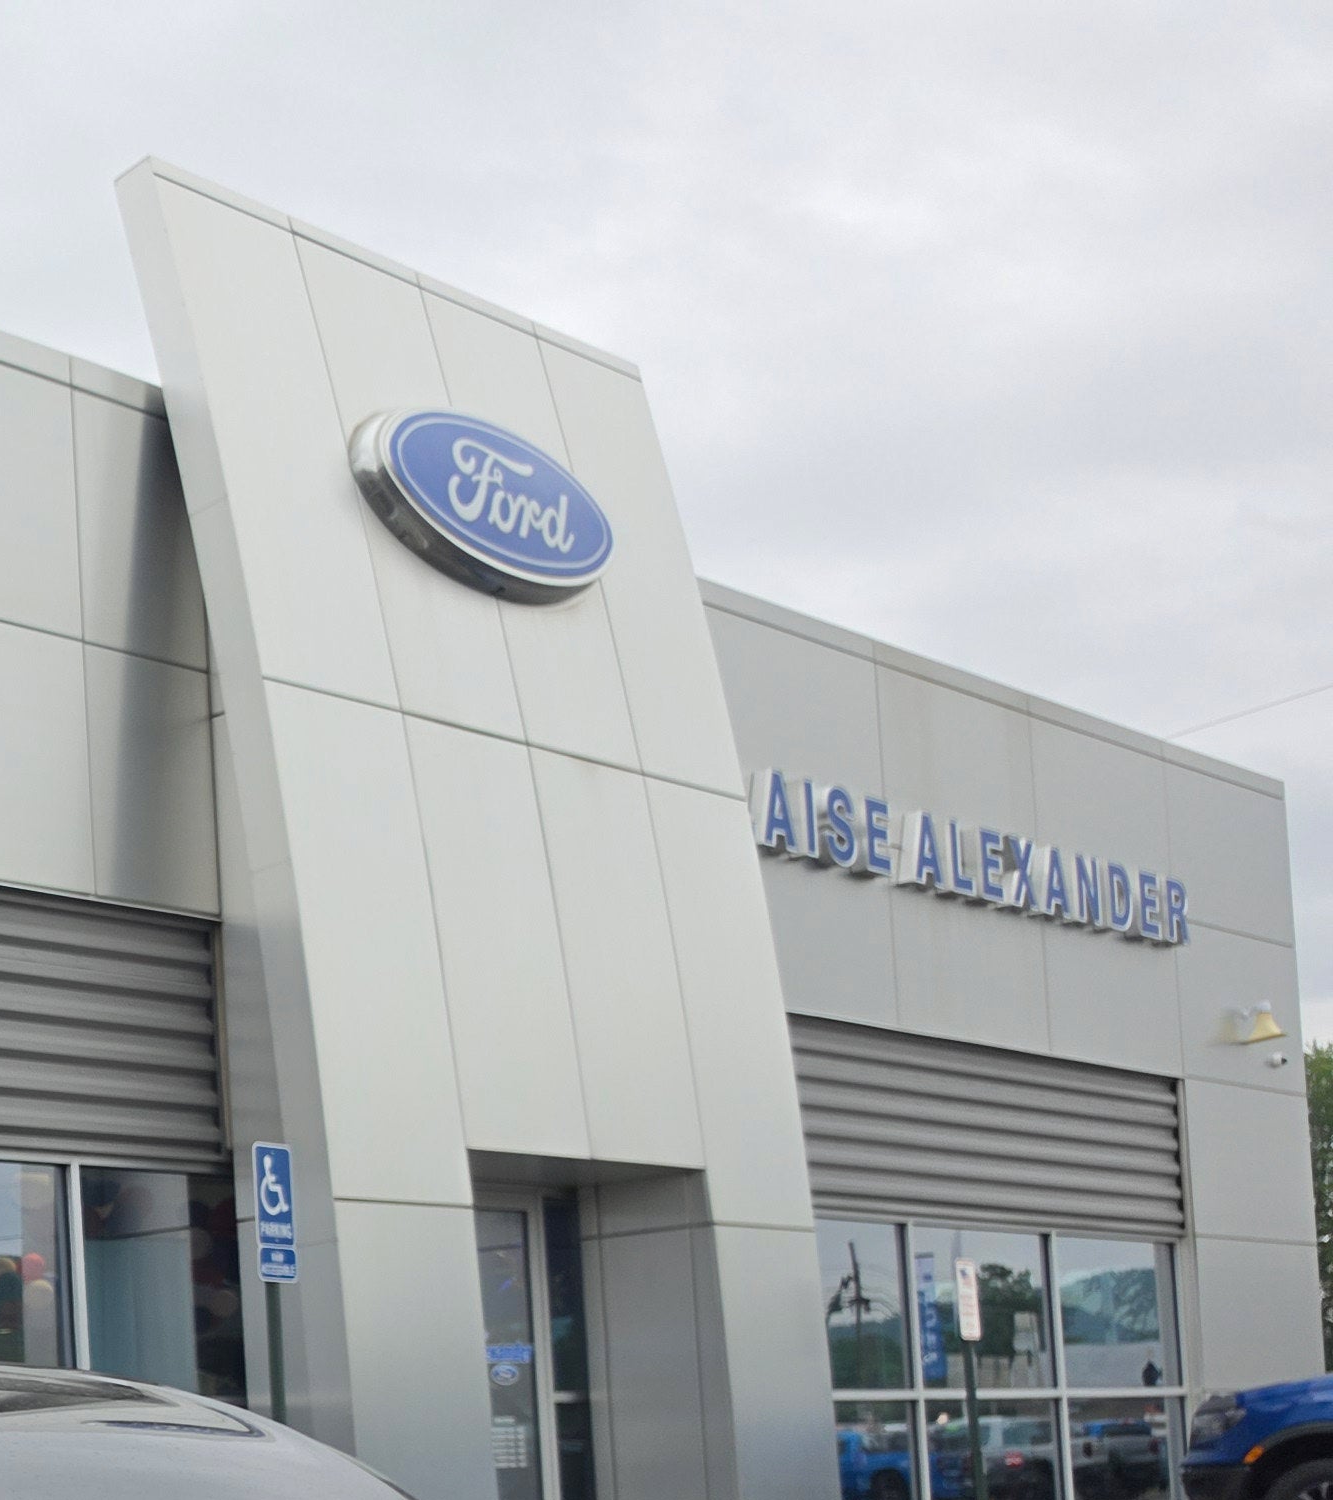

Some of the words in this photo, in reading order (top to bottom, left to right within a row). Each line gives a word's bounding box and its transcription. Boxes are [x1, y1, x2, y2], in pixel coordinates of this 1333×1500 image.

[448, 437, 575, 554] Ford
[761, 766, 892, 877] AISE
[911, 810, 1191, 946] ALEXANDER
